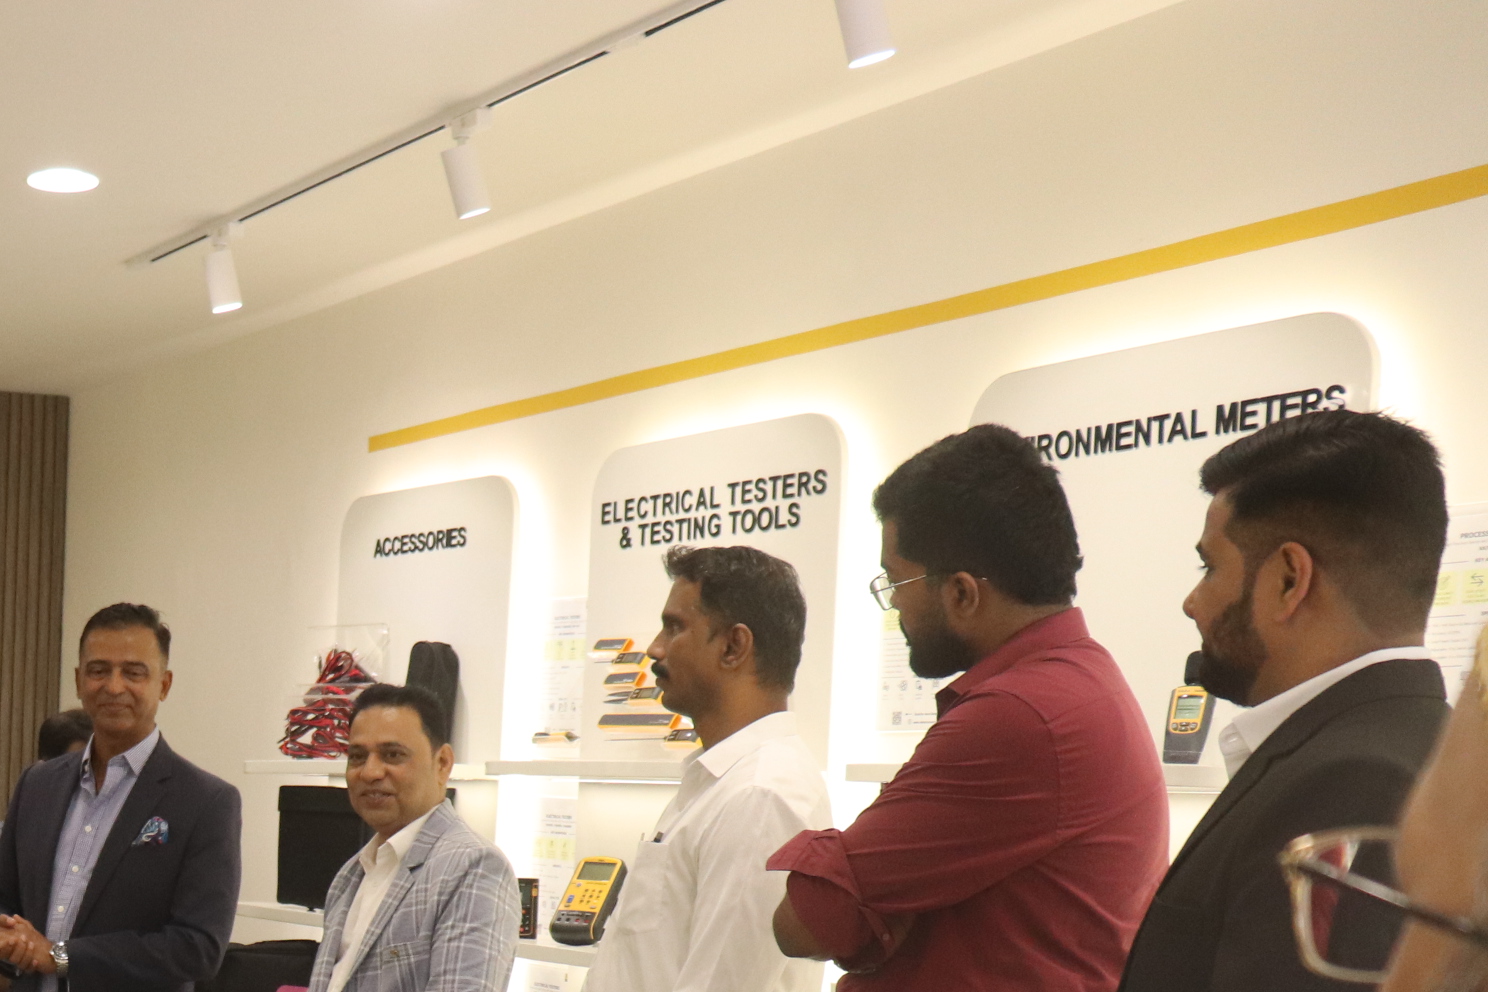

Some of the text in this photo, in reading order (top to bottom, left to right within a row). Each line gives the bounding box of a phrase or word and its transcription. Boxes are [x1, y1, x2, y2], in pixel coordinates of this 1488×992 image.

[1034, 410, 1207, 461] RONMENTAL
[601, 469, 828, 525] ELECTRICAL TESTERS
[373, 526, 467, 558] ACCESSORIES
[619, 503, 801, 548] & TESTING TOOLS
